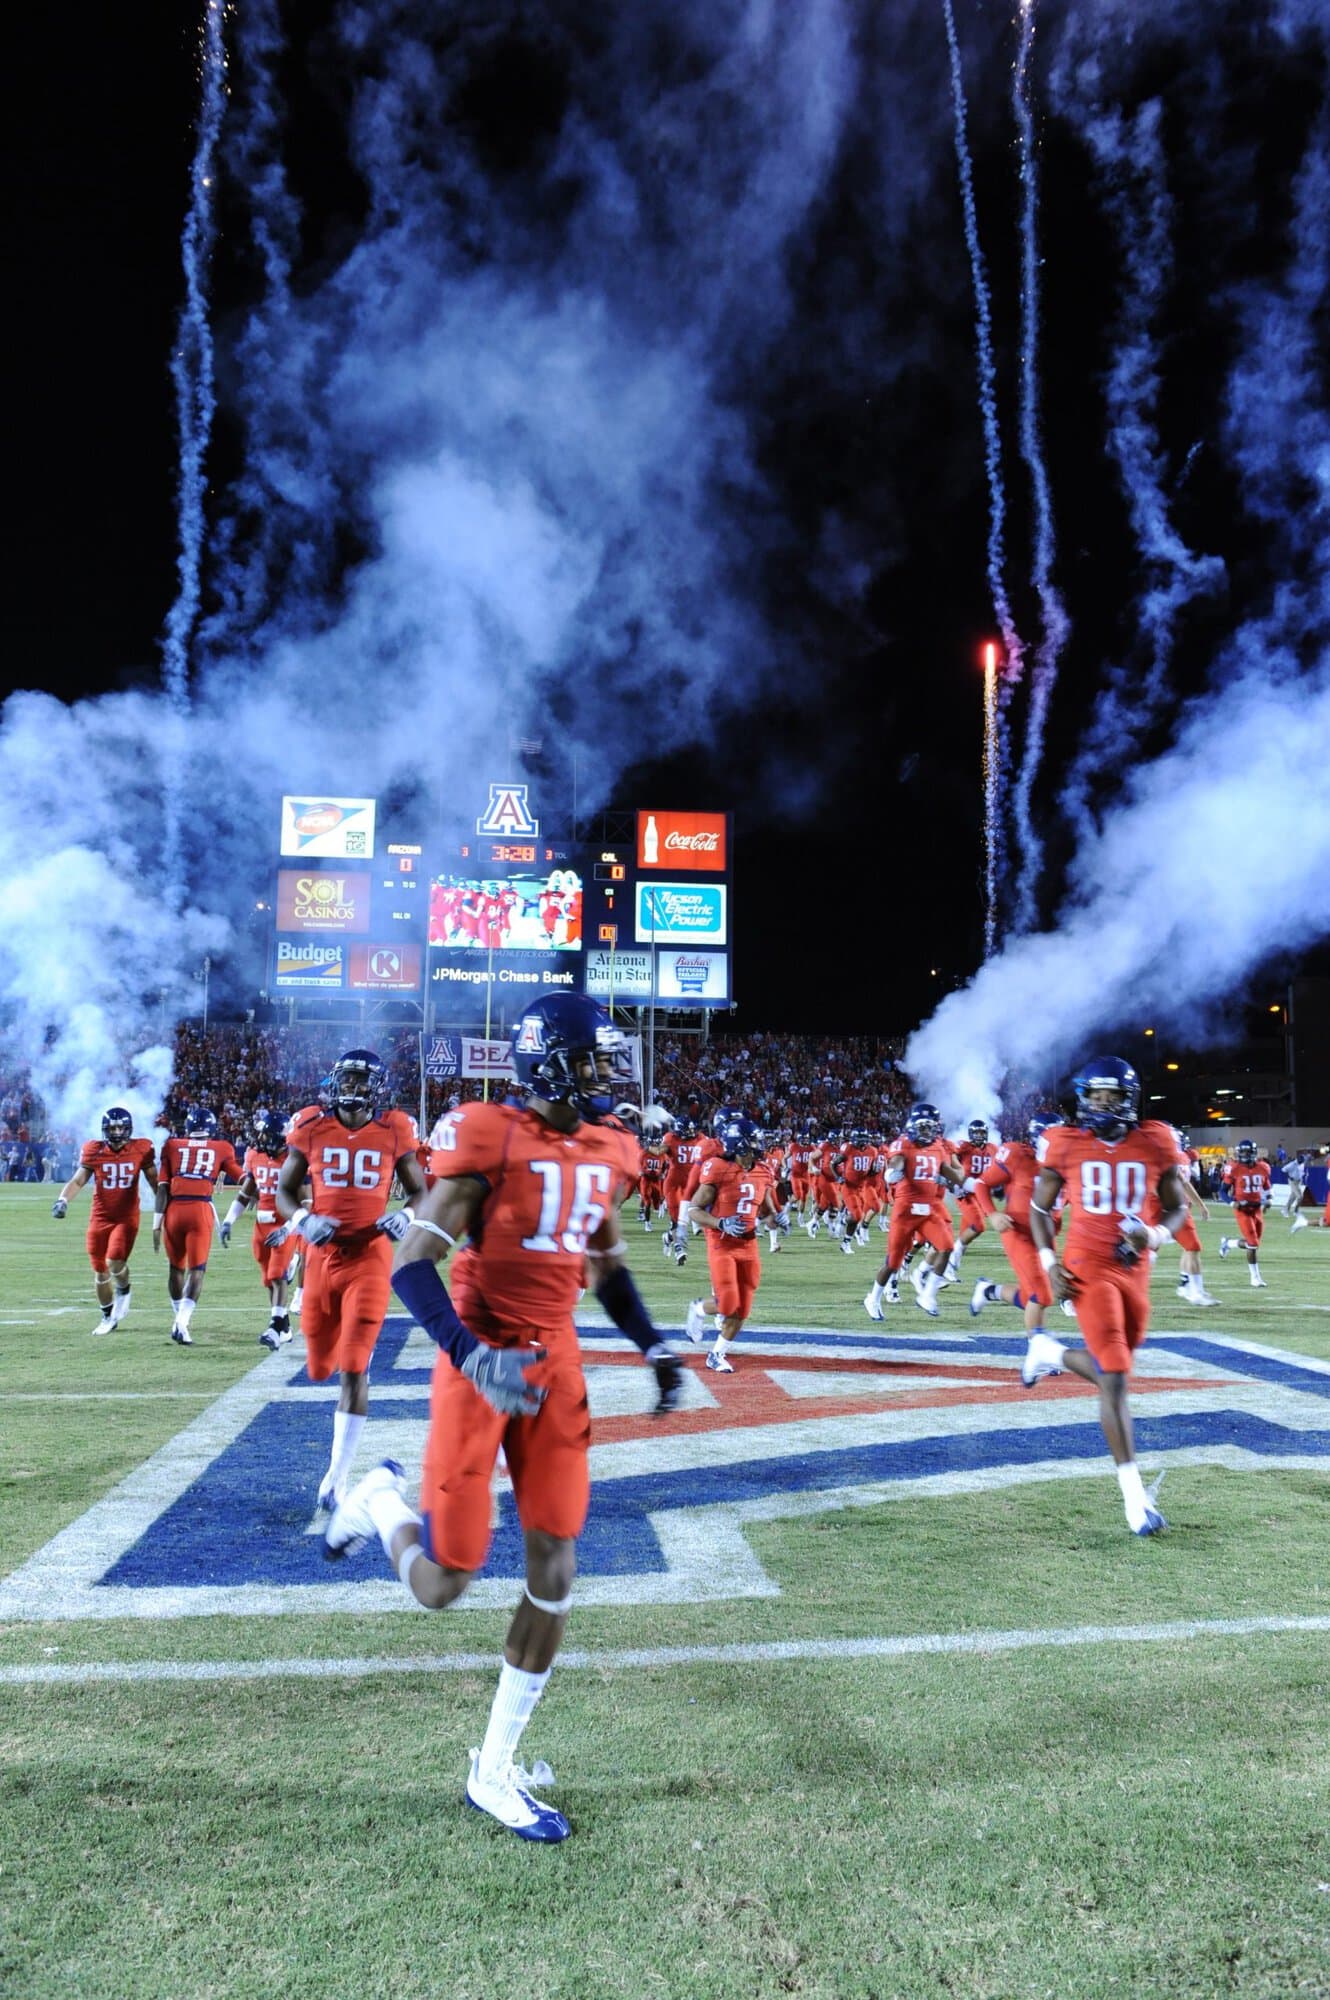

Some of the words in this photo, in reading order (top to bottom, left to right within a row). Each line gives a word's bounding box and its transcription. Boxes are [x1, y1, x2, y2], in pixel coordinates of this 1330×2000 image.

[665, 831, 720, 851] Coca-Cola
[491, 845, 535, 862] 3:28
[545, 850, 553, 860] 3
[611, 866, 624, 879] 0
[294, 878, 355, 906] SOL
[661, 891, 703, 904] Tucson
[294, 906, 355, 920] CASINOS
[665, 903, 714, 915] Electric
[669, 915, 713, 926] Power
[277, 941, 343, 965] Budget
[432, 968, 496, 984] JPMorgan
[499, 970, 539, 982] Chase
[542, 971, 574, 984] Bank
[425, 1065, 457, 1076] CLUB
[178, 1147, 216, 1178] 18
[322, 1147, 382, 1190] 26
[702, 1161, 713, 1176] 2
[913, 1155, 938, 1181] 21
[102, 1162, 135, 1190] 35
[1242, 1174, 1264, 1194] 19
[1080, 1160, 1148, 1216] 80
[521, 1159, 612, 1254] 16
[736, 1182, 756, 1215] 2
